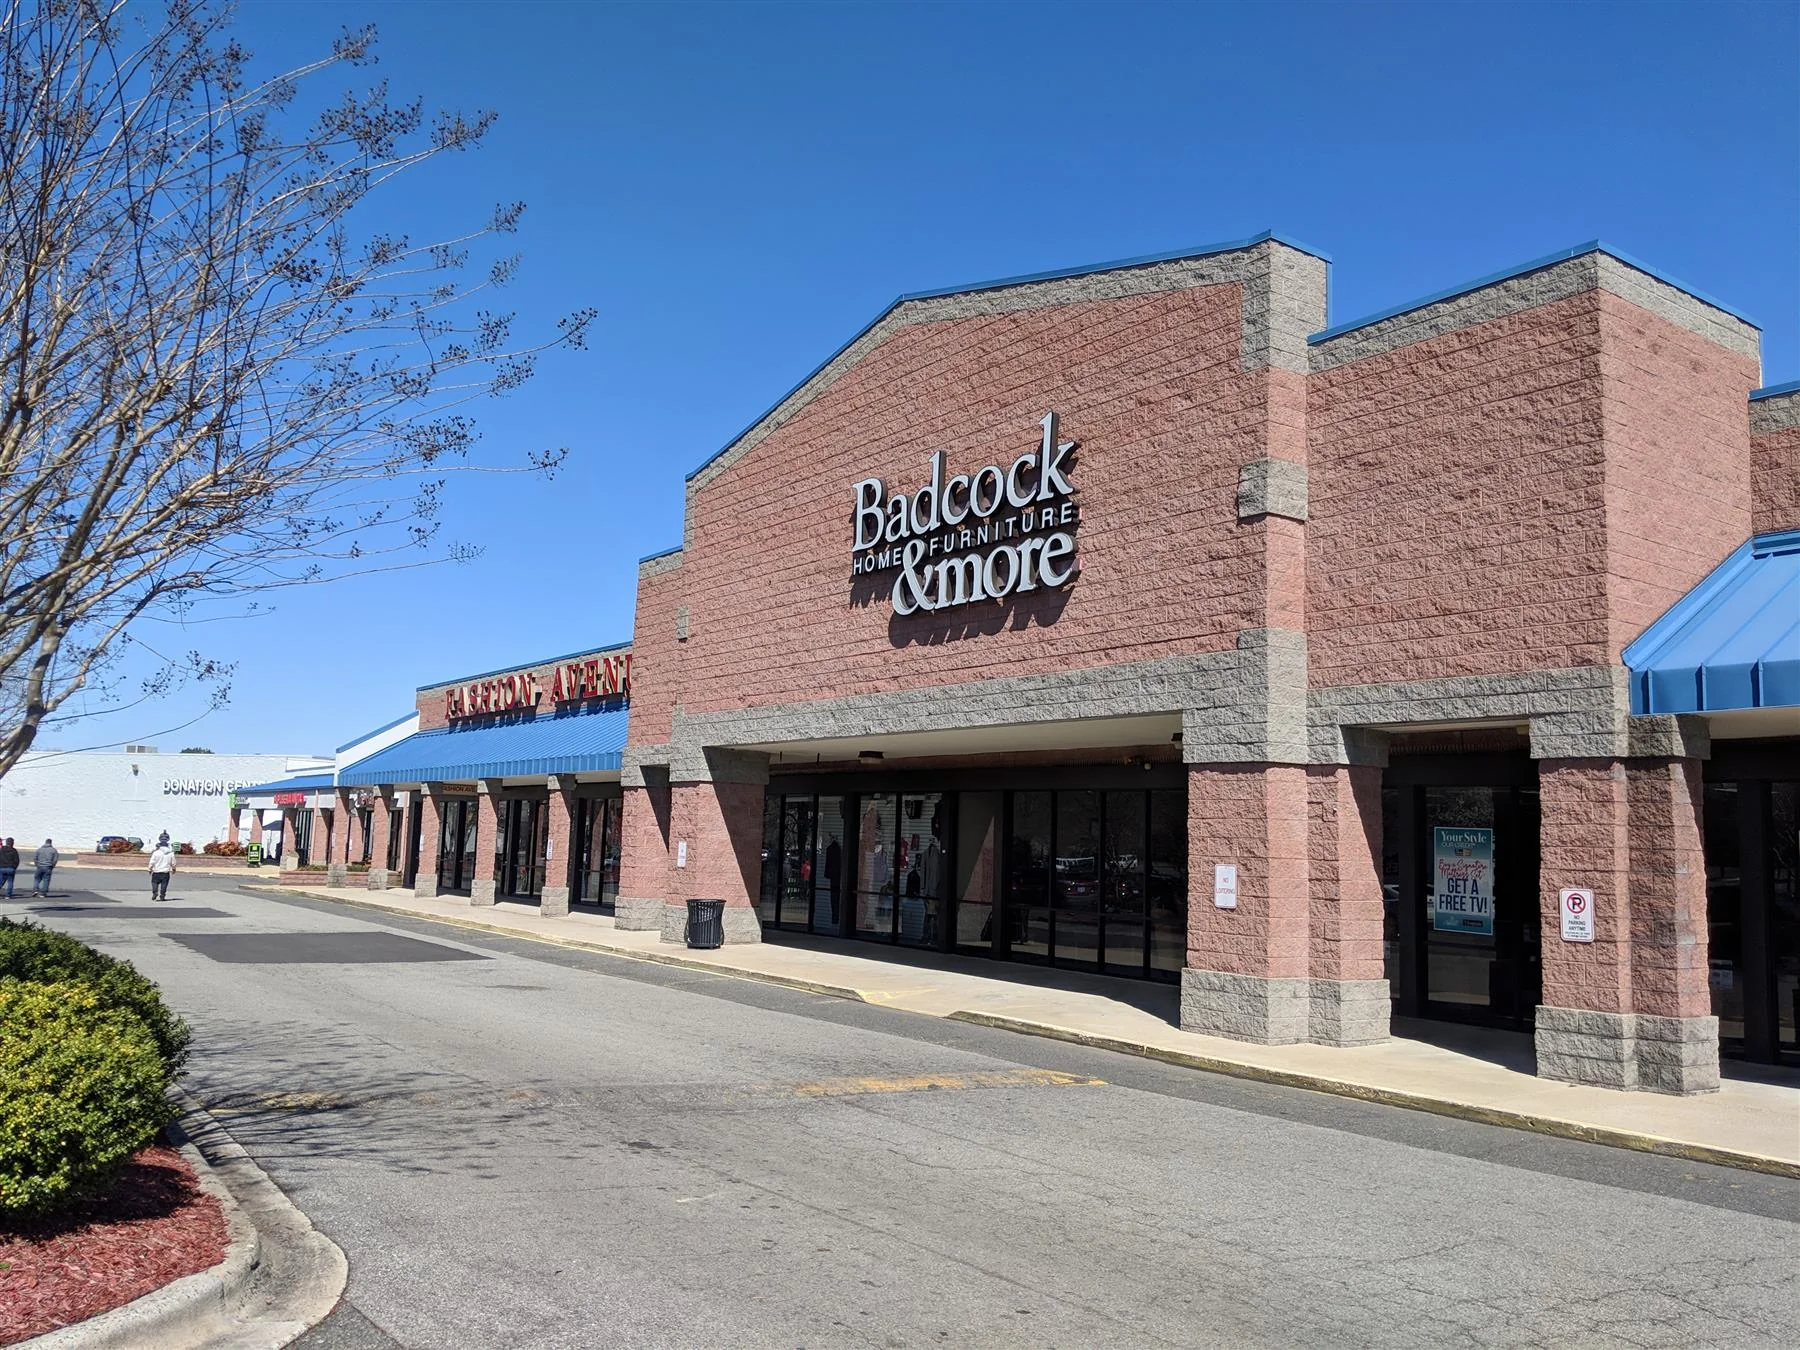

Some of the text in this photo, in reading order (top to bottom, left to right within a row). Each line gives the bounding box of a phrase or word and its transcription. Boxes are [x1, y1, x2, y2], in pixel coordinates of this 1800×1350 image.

[852, 410, 1076, 552] Badcock
[853, 501, 1075, 576] HOME FURNITURE
[891, 532, 1075, 617] &more
[445, 672, 538, 720] FASHION
[162, 778, 223, 795] DONATION
[1440, 830, 1487, 844] Your Style
[1447, 878, 1479, 895] GET A
[1439, 894, 1487, 913] FREE TV!
